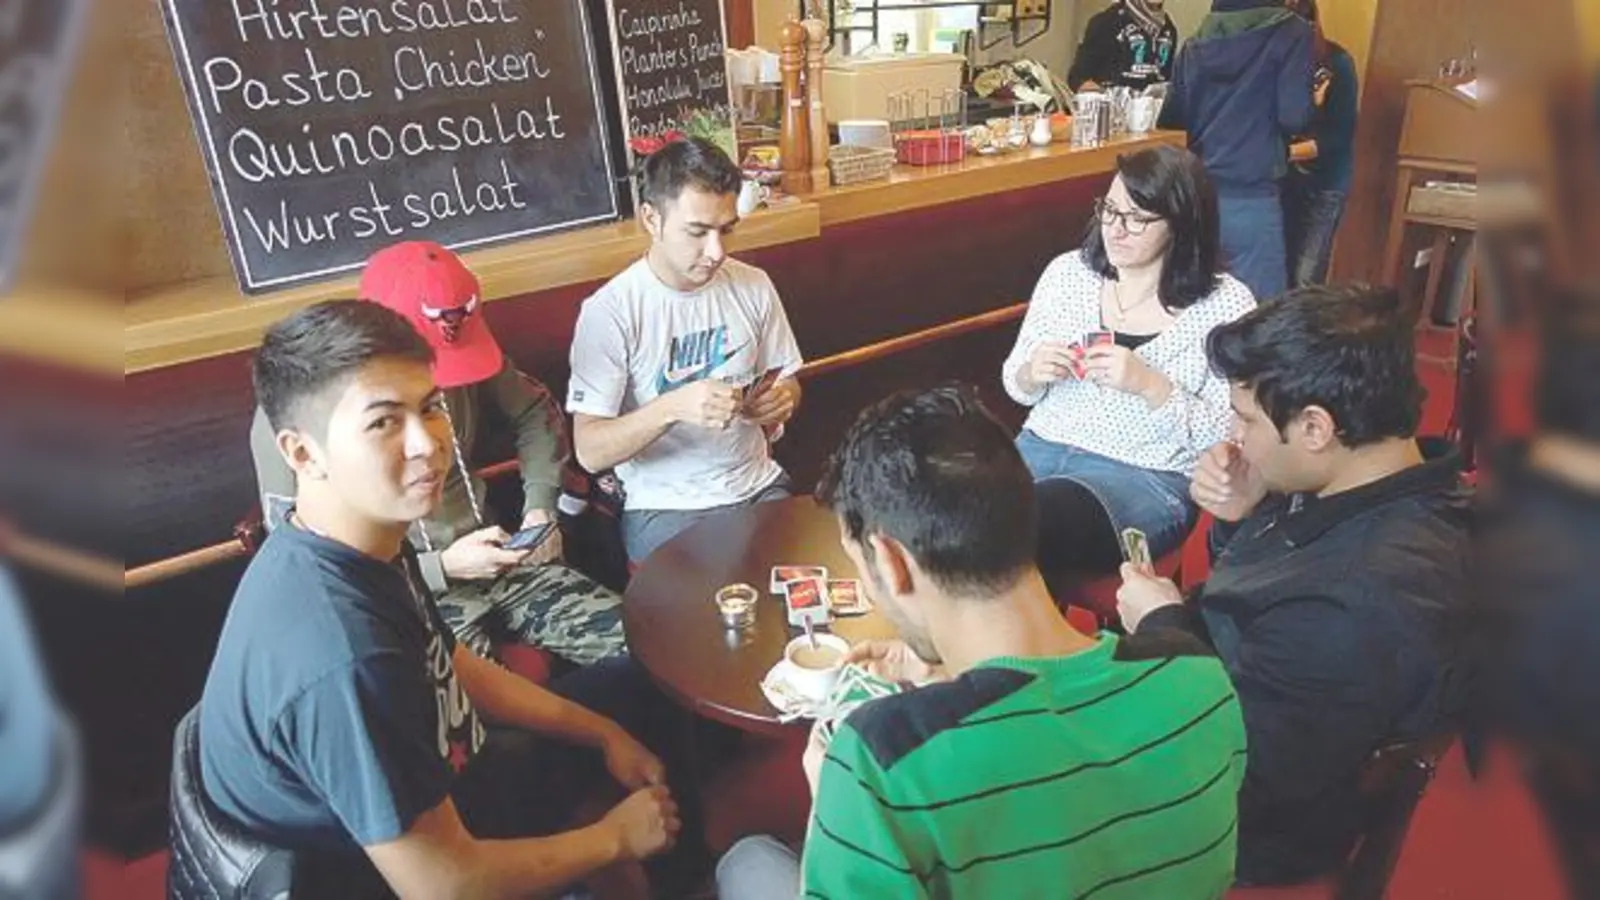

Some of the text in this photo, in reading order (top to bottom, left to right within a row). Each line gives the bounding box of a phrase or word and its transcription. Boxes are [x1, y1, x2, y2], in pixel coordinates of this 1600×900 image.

[202, 48, 372, 114] Pasta
[229, 96, 566, 183] Quinoasalat
[243, 159, 527, 254] Wurstsalat
[668, 324, 729, 372] NIKE
